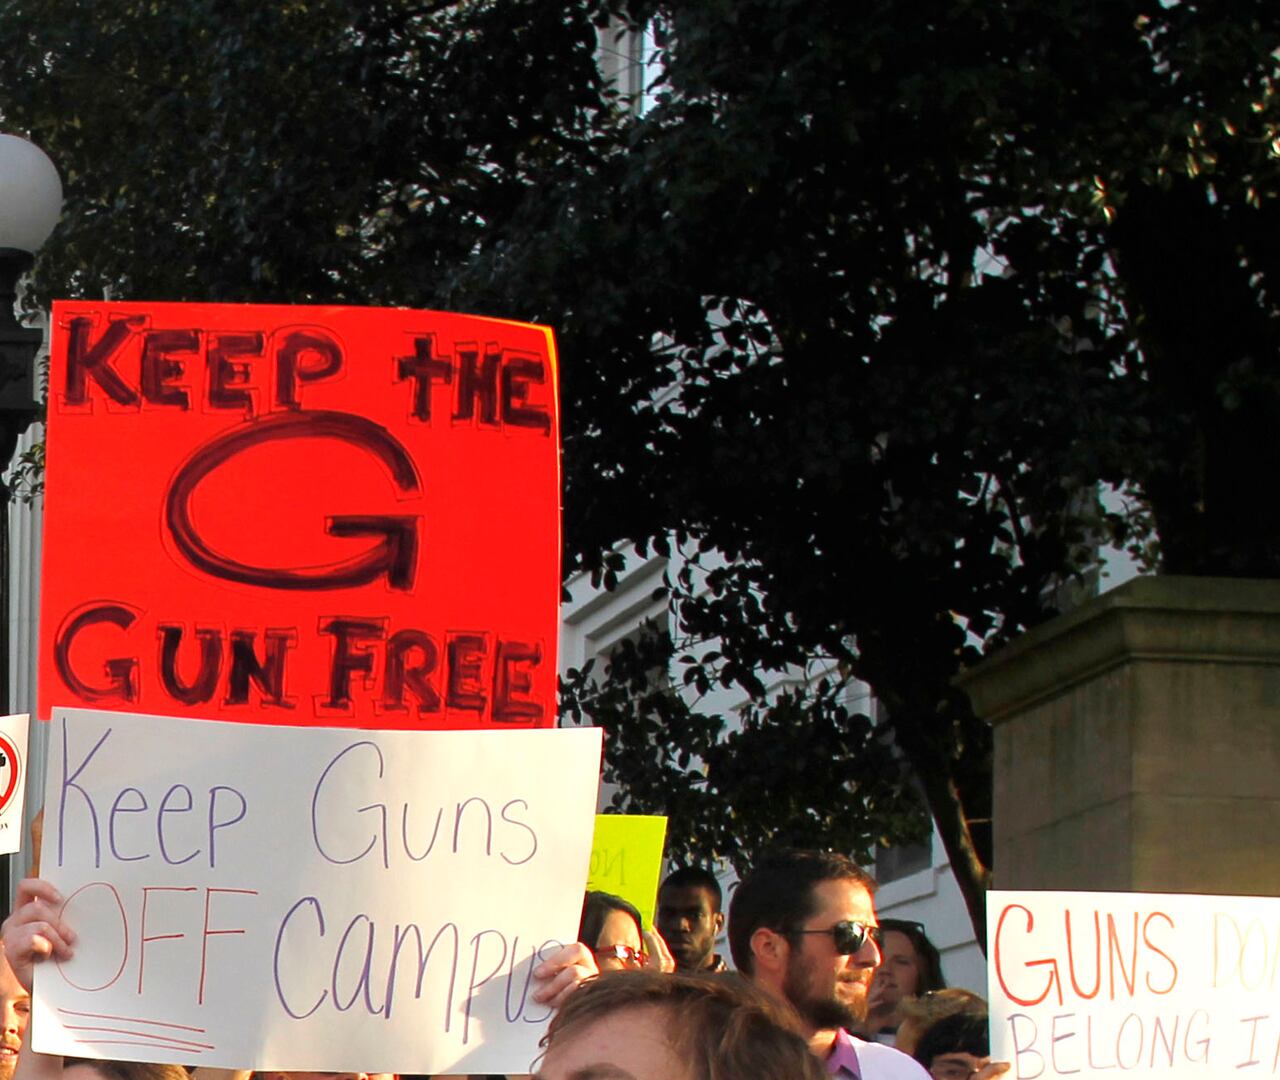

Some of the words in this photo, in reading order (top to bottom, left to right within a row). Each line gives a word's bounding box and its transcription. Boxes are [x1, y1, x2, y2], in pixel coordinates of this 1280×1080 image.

[57, 311, 346, 419] KEEP
[159, 410, 424, 596] G
[53, 600, 298, 711] GUN
[315, 615, 546, 727] FREE
[55, 882, 259, 1005] OFF
[994, 904, 1178, 1006] GUNS
[1006, 1009, 1211, 1080] BELONG
